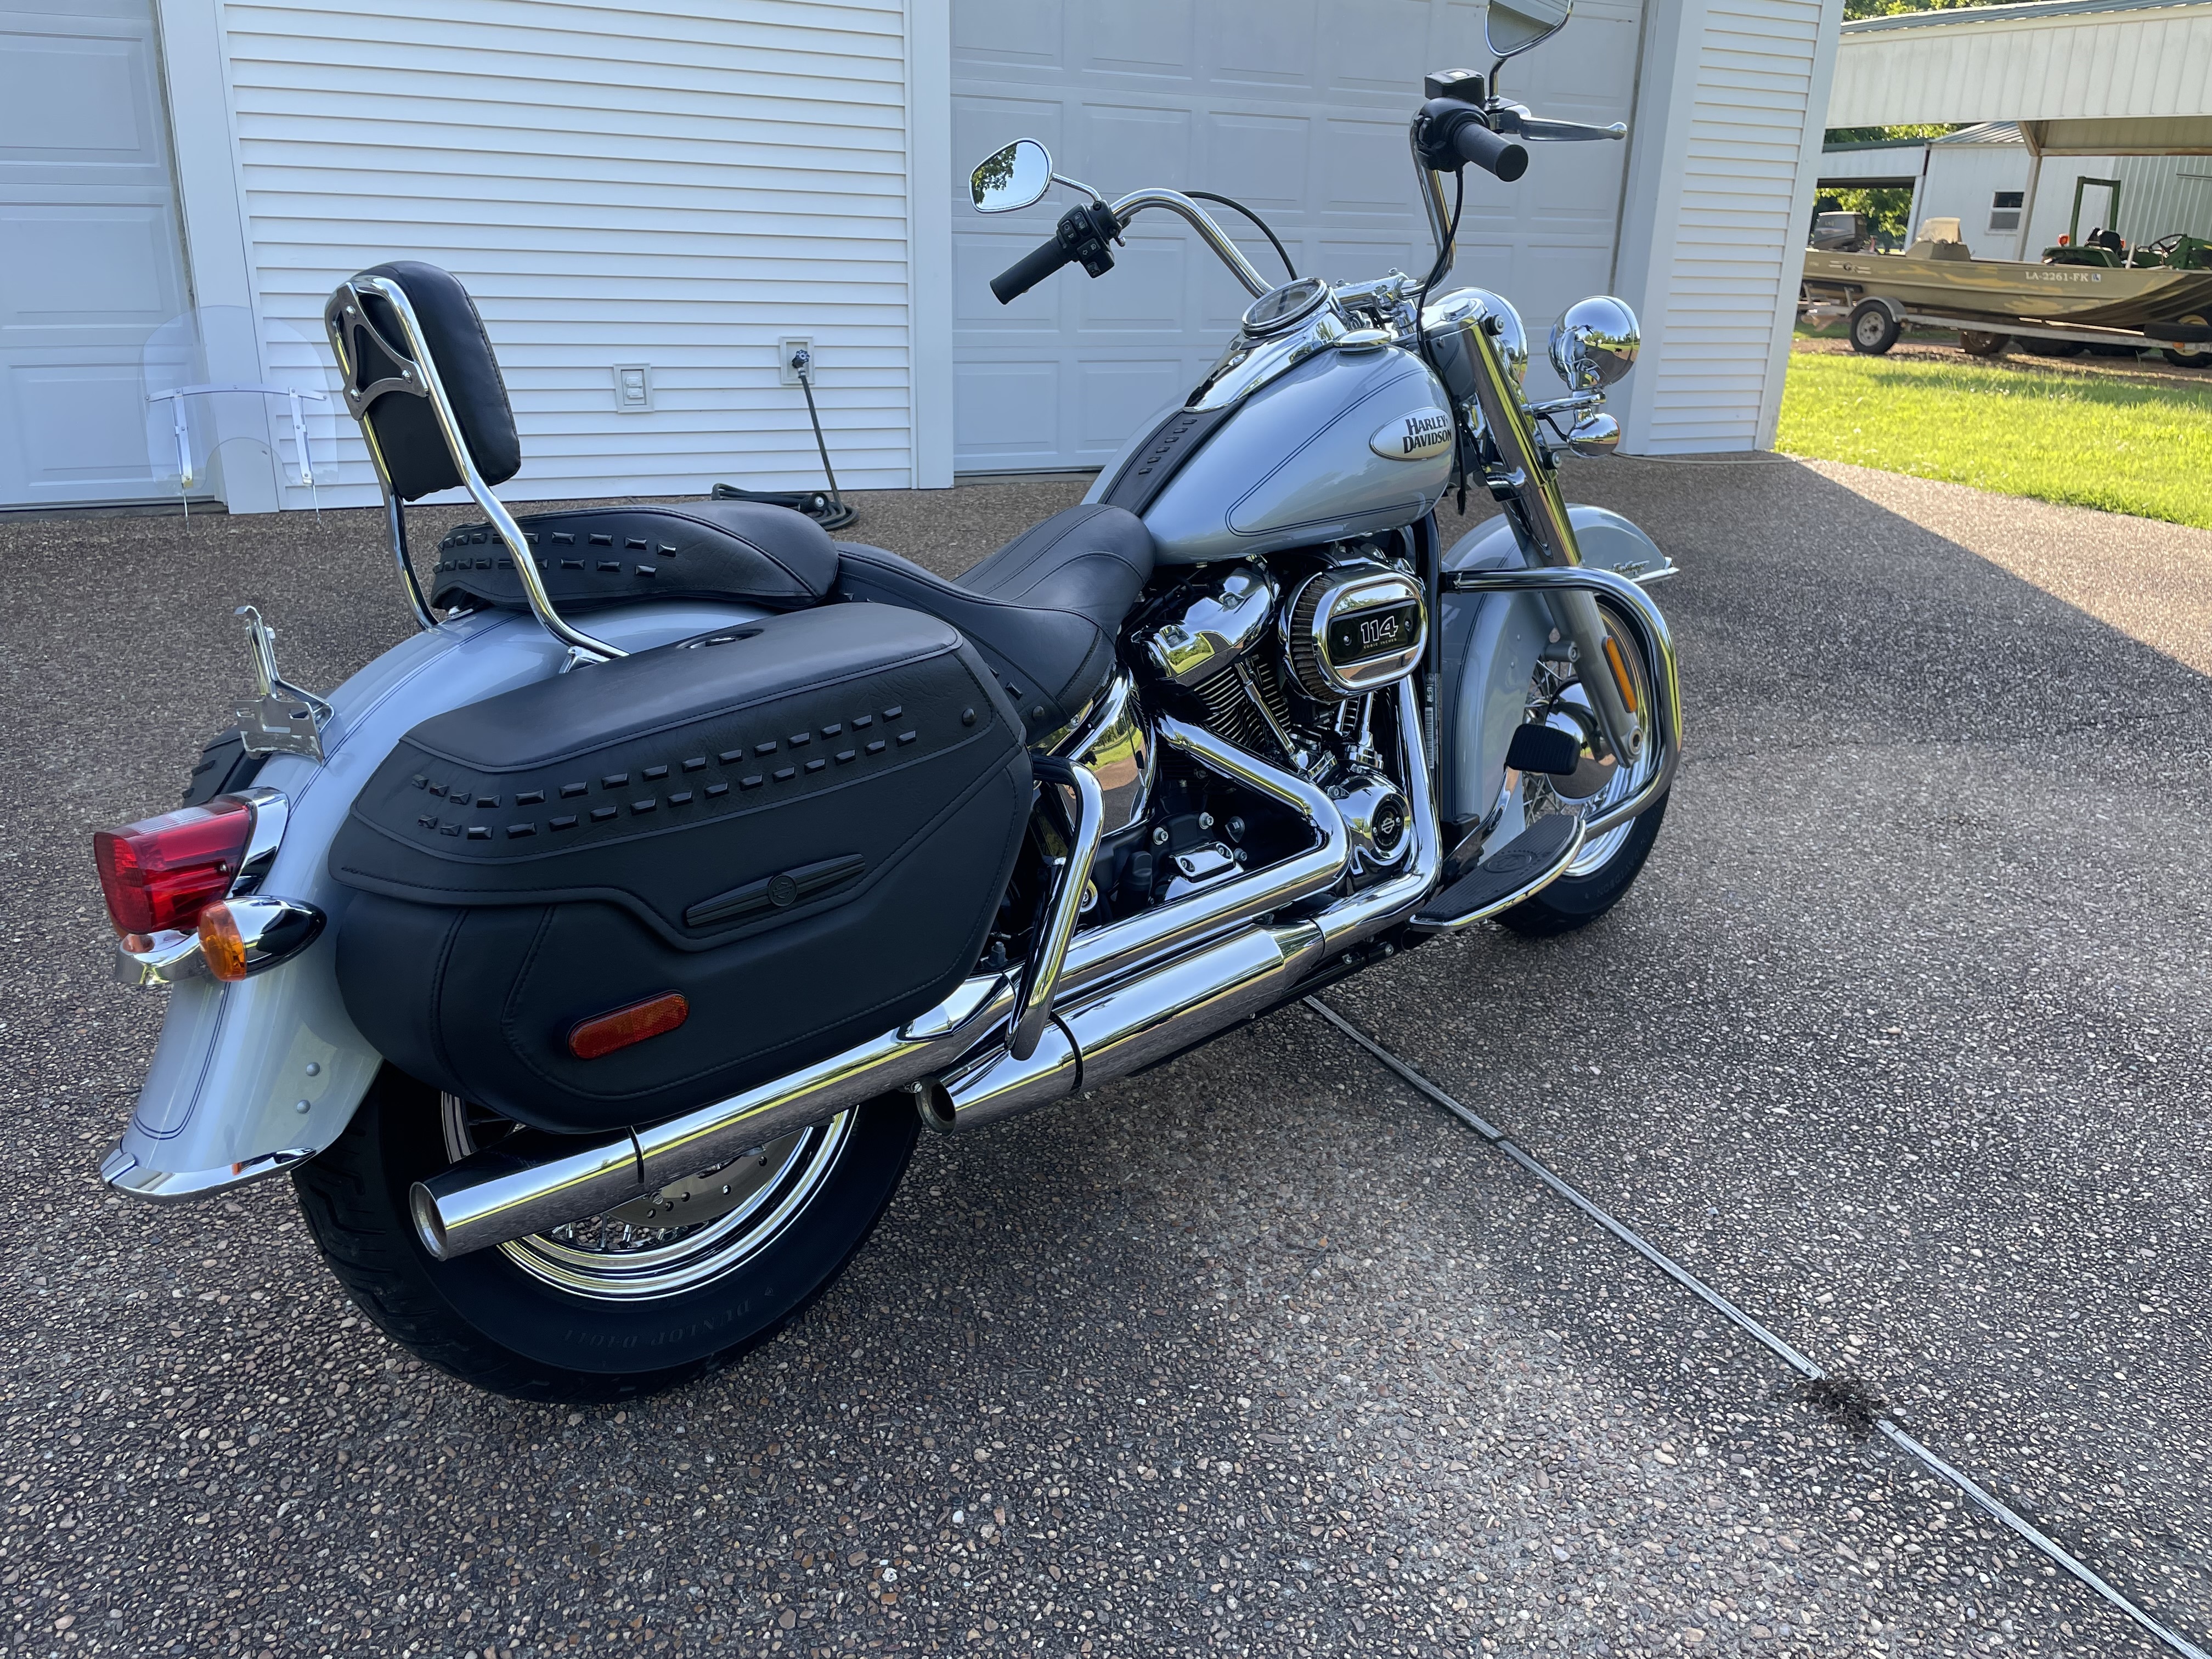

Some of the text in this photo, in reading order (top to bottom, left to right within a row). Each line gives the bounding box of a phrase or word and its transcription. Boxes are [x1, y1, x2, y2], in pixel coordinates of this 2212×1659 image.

[2025, 271, 2089, 282] LA-2261-FK
[1402, 428, 1452, 454] DAVIDSON
[1361, 615, 1399, 644] 114
[651, 1298, 752, 1347] DUNLOP
